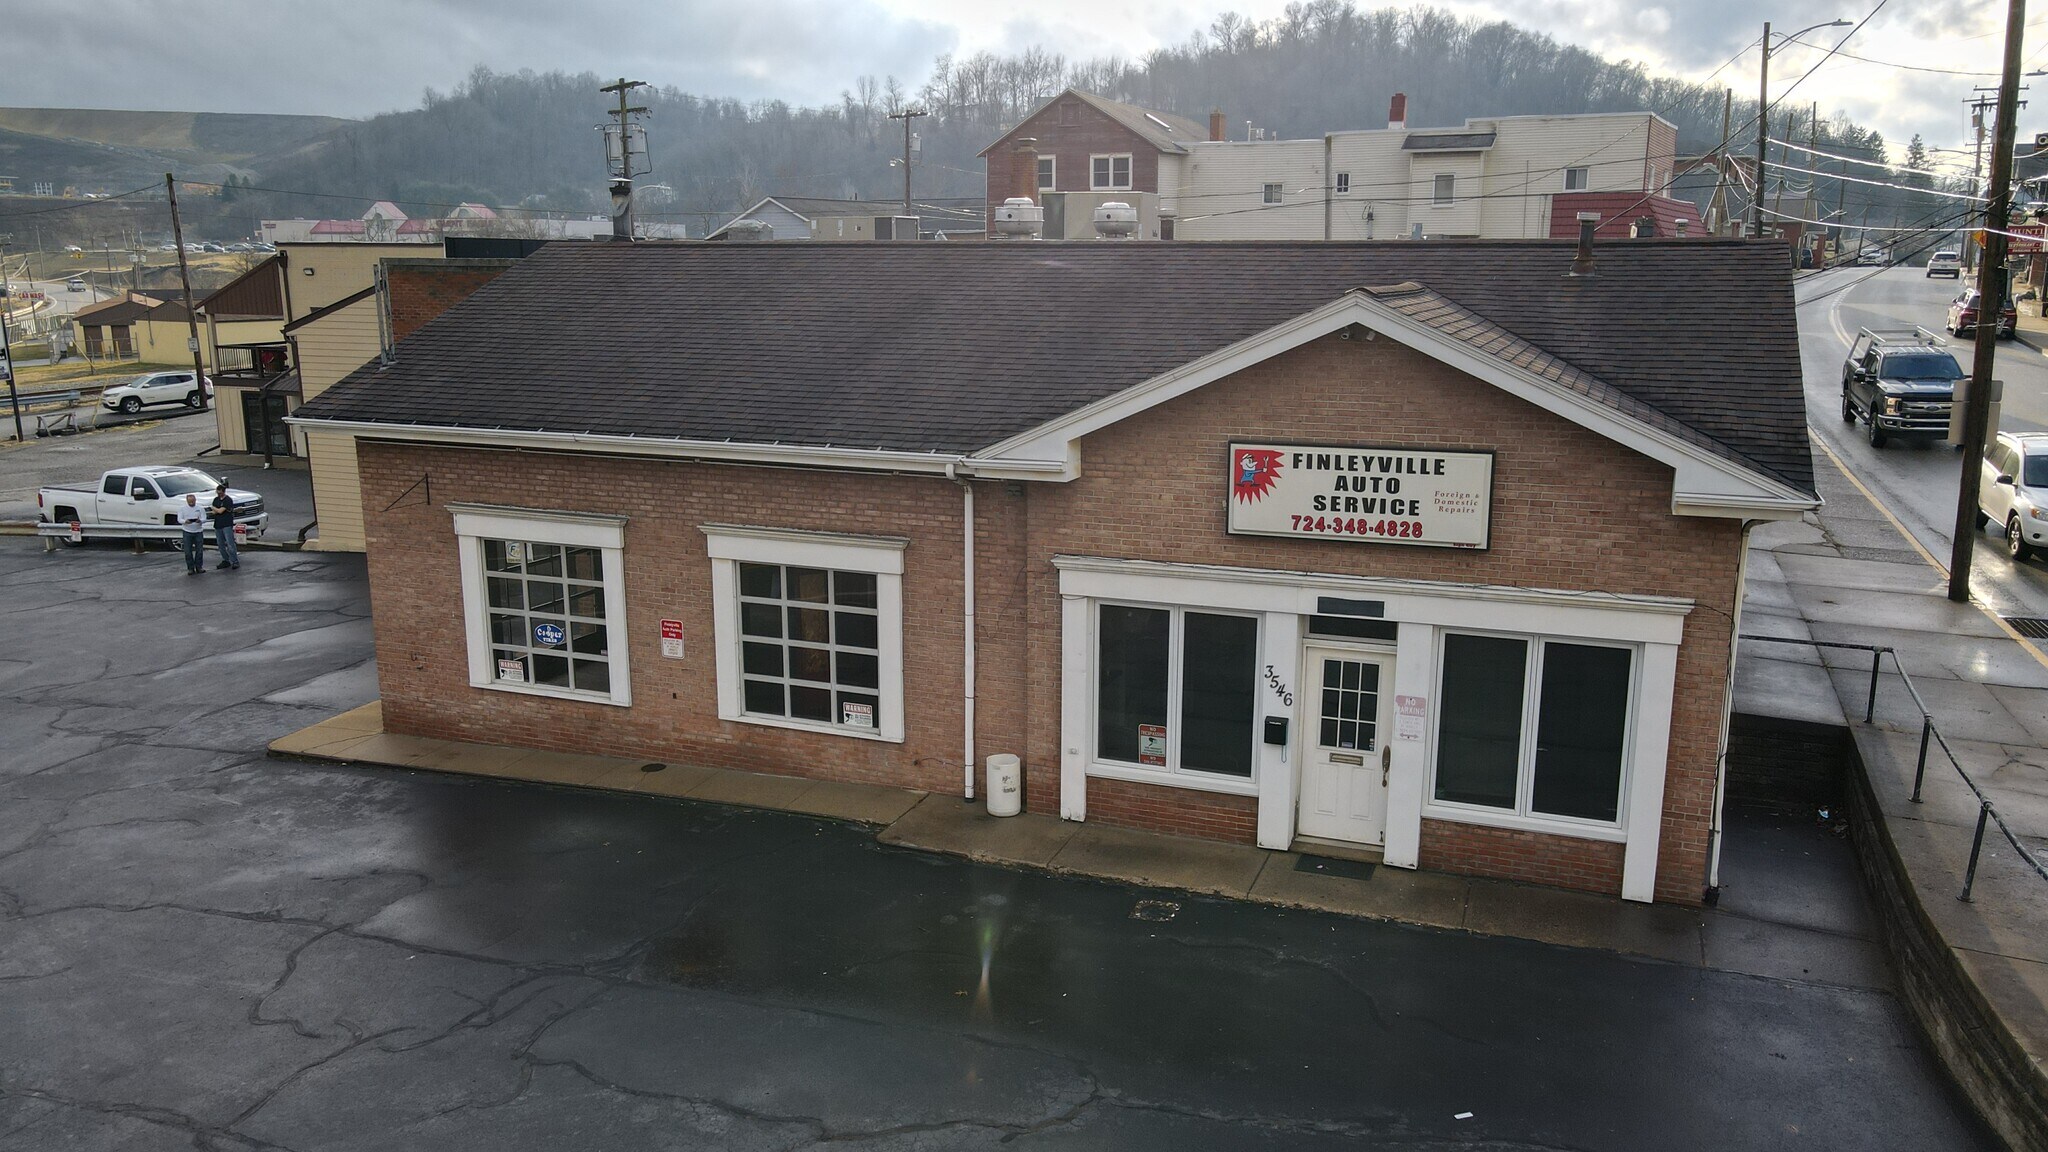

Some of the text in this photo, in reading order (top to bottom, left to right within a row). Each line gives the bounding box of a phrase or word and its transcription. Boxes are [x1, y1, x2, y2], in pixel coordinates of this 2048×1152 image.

[1292, 453, 1445, 476] FINLEYVILLE
[1334, 475, 1401, 495] AUTO
[1433, 498, 1478, 506] Domestic
[1434, 490, 1471, 500] Foreign
[1313, 494, 1420, 516] SERVICE
[1438, 505, 1475, 514] Repairs
[1264, 665, 1293, 706] 3546
[845, 704, 871, 714] WARNING
